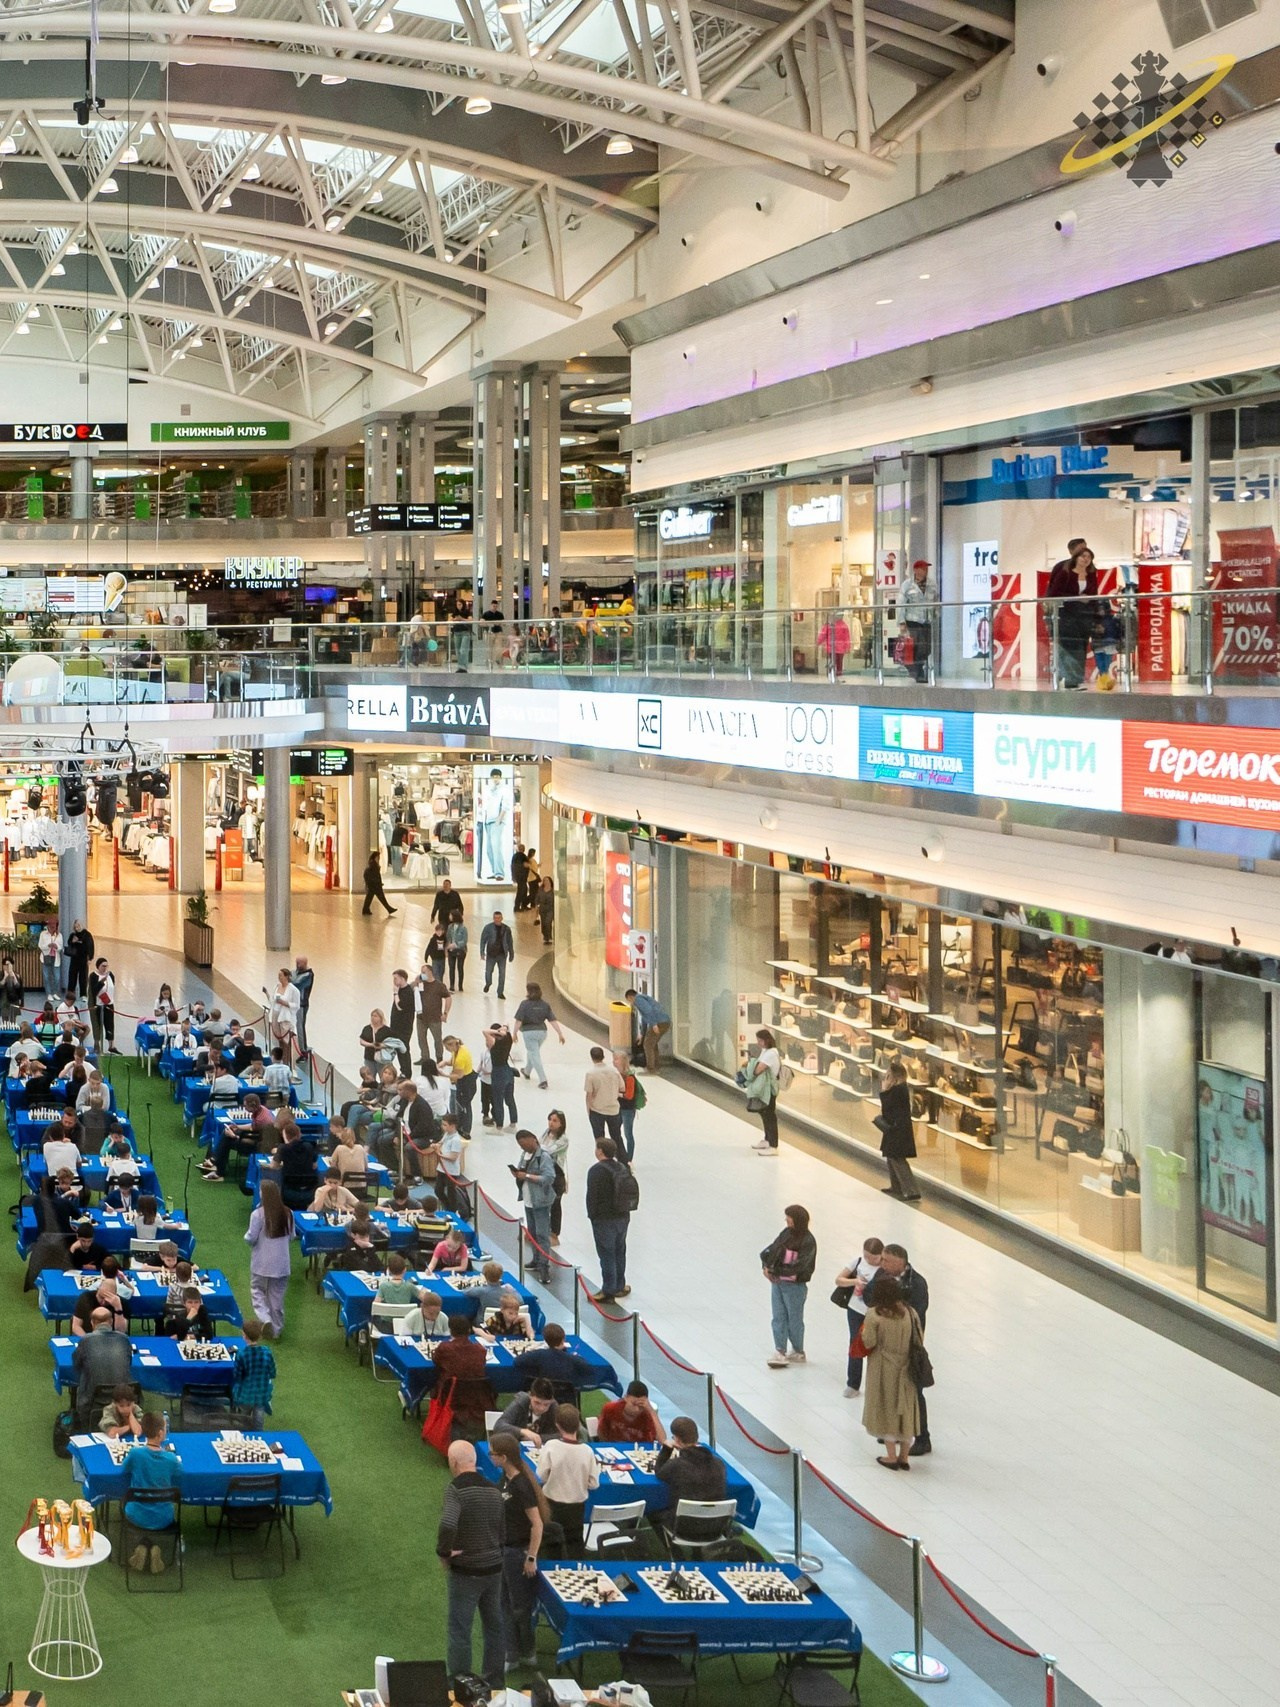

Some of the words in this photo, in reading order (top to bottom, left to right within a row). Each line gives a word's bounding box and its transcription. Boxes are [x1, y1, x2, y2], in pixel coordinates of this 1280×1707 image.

[174, 425, 234, 437] КНИЖНЫЙ
[238, 426, 267, 437] КЛУБ
[992, 454, 1057, 483] Button
[1061, 445, 1109, 473] Blue
[224, 555, 304, 580] КУКУМБЕР
[246, 581, 282, 589] РЕСТОРАН
[1222, 600, 1272, 616] СКИДКА
[1222, 625, 1274, 652] 70%
[410, 693, 490, 726] BrávA
[640, 714, 658, 734] XC
[785, 706, 834, 745] 1001
[866, 750, 906, 767] EXPRESS
[907, 753, 964, 774] TRATTORIA
[995, 723, 1097, 780] ёгурти
[1143, 738, 1280, 786] Теремок
[1143, 786, 1189, 801] РЕСТОРАН
[1189, 792, 1246, 808] ДОМАШНЕЙ
